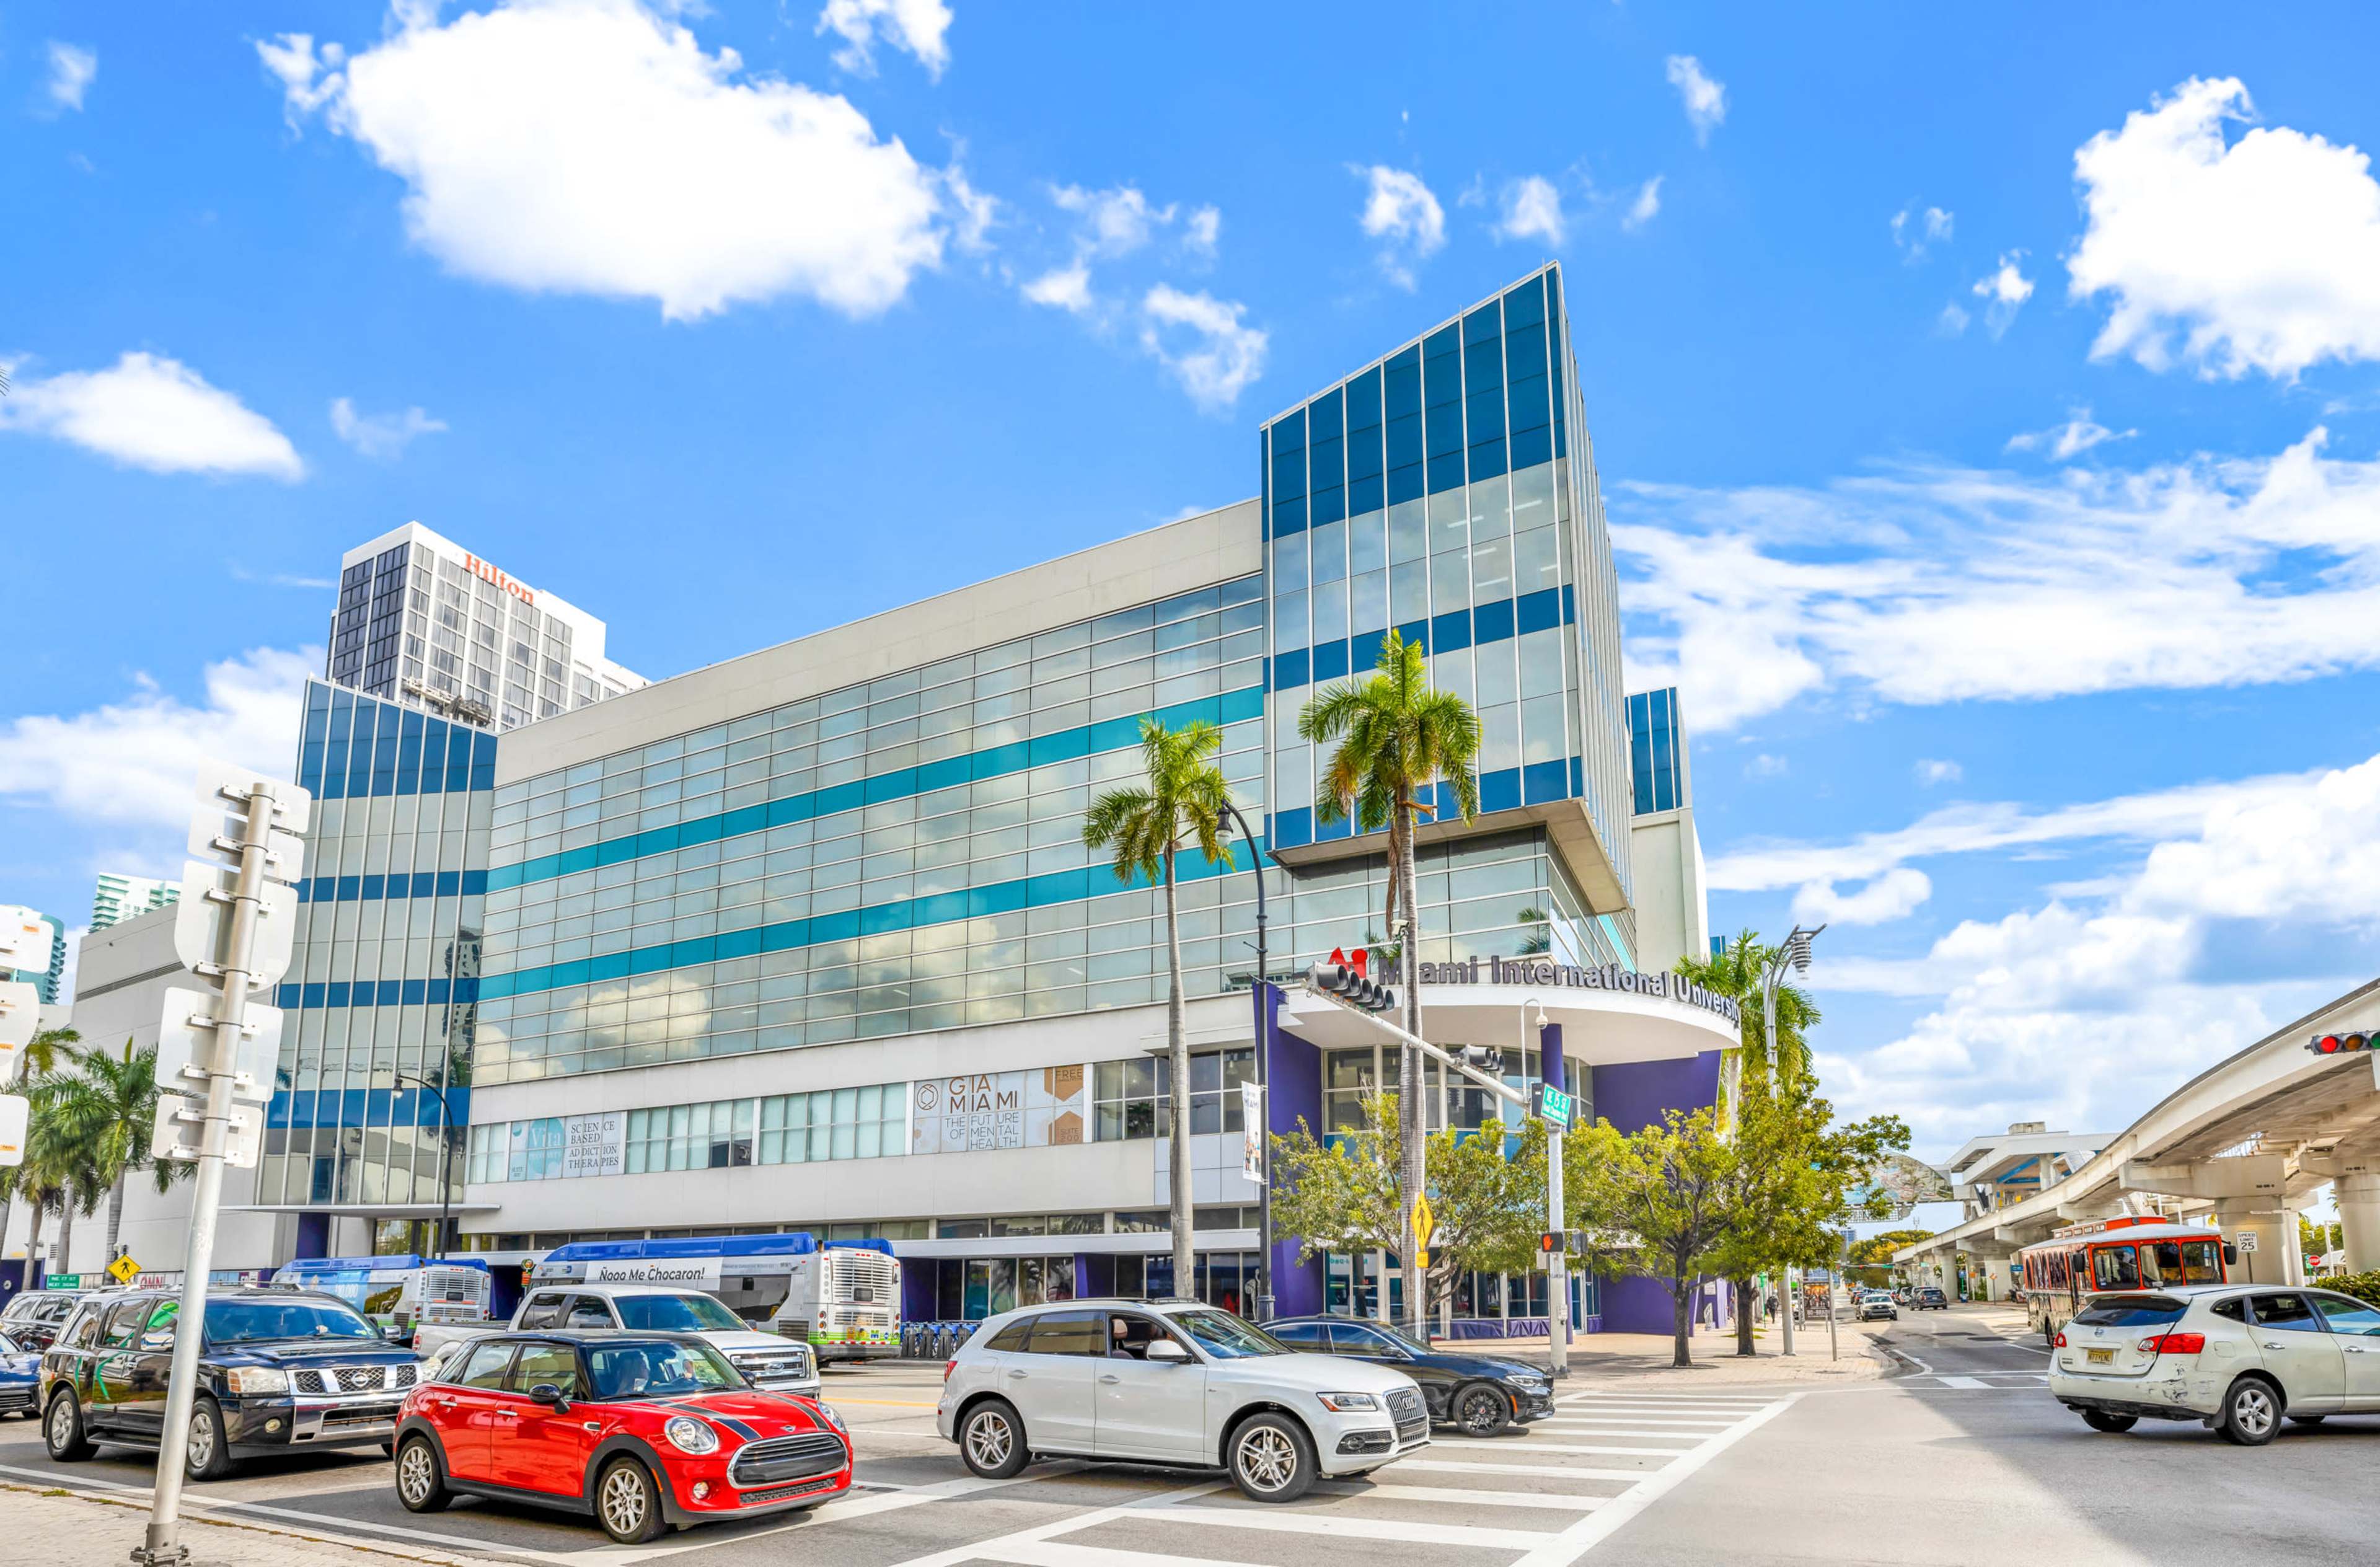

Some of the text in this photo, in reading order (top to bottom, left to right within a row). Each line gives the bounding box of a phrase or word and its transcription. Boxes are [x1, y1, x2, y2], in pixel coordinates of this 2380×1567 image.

[465, 553, 534, 605] Hilton
[1378, 955, 1478, 985] Mami
[1491, 955, 1672, 997] International
[1056, 1069, 1082, 1079] FREE
[949, 1074, 992, 1095] GIA
[950, 1090, 1018, 1114] MIAMI
[945, 1111, 1020, 1128] THE FUTURE
[571, 1120, 615, 1134] SCIENCE
[950, 1124, 1020, 1140] OF MENTAL
[1060, 1127, 1080, 1135] SUITE
[571, 1133, 601, 1145] BASED
[971, 1137, 1017, 1150] HEALTH
[1060, 1134, 1080, 1142] 200
[569, 1145, 618, 1158] ADDICTION
[568, 1157, 619, 1170] THERAPIES
[2241, 1242, 2255, 1251] 25
[599, 1266, 705, 1281] Ñooo Me Chocaron!
